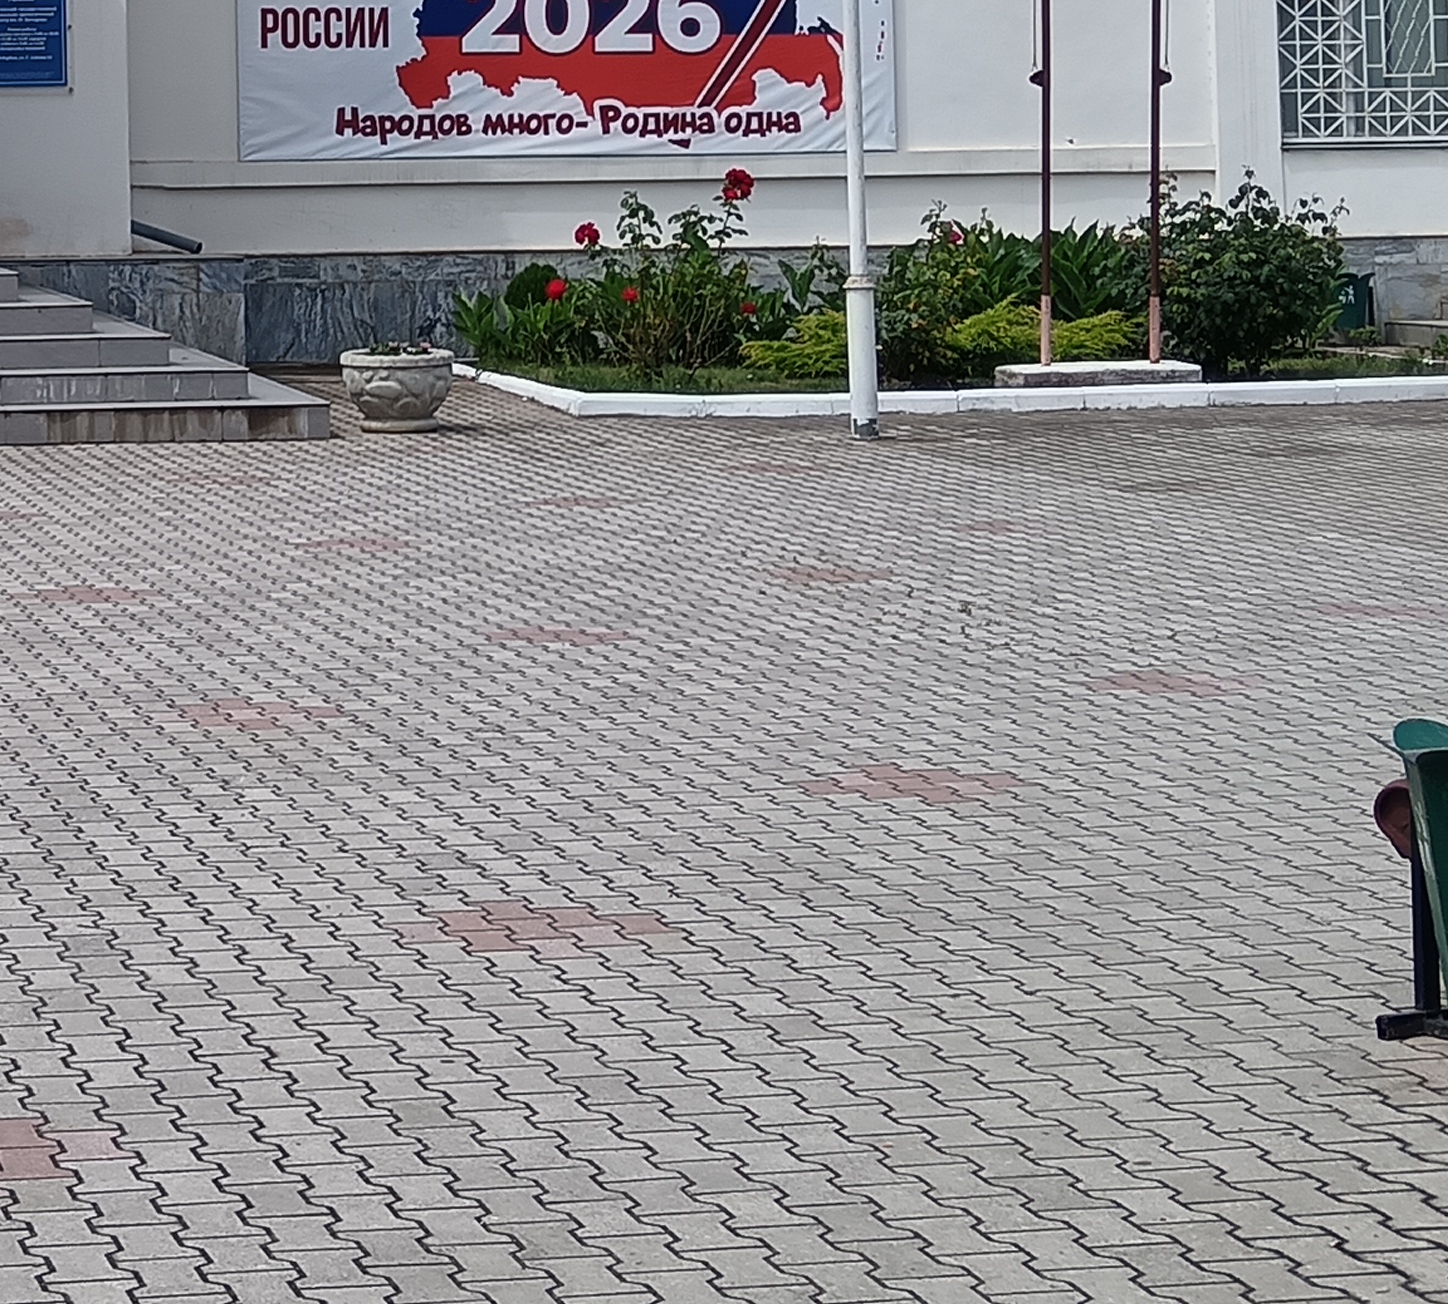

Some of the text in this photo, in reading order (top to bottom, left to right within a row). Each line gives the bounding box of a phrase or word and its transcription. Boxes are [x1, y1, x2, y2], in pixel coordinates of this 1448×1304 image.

[260, 6, 390, 49] РОССИИ
[335, 106, 472, 145] Народов
[599, 104, 716, 138] Родина
[724, 109, 802, 139] одна
